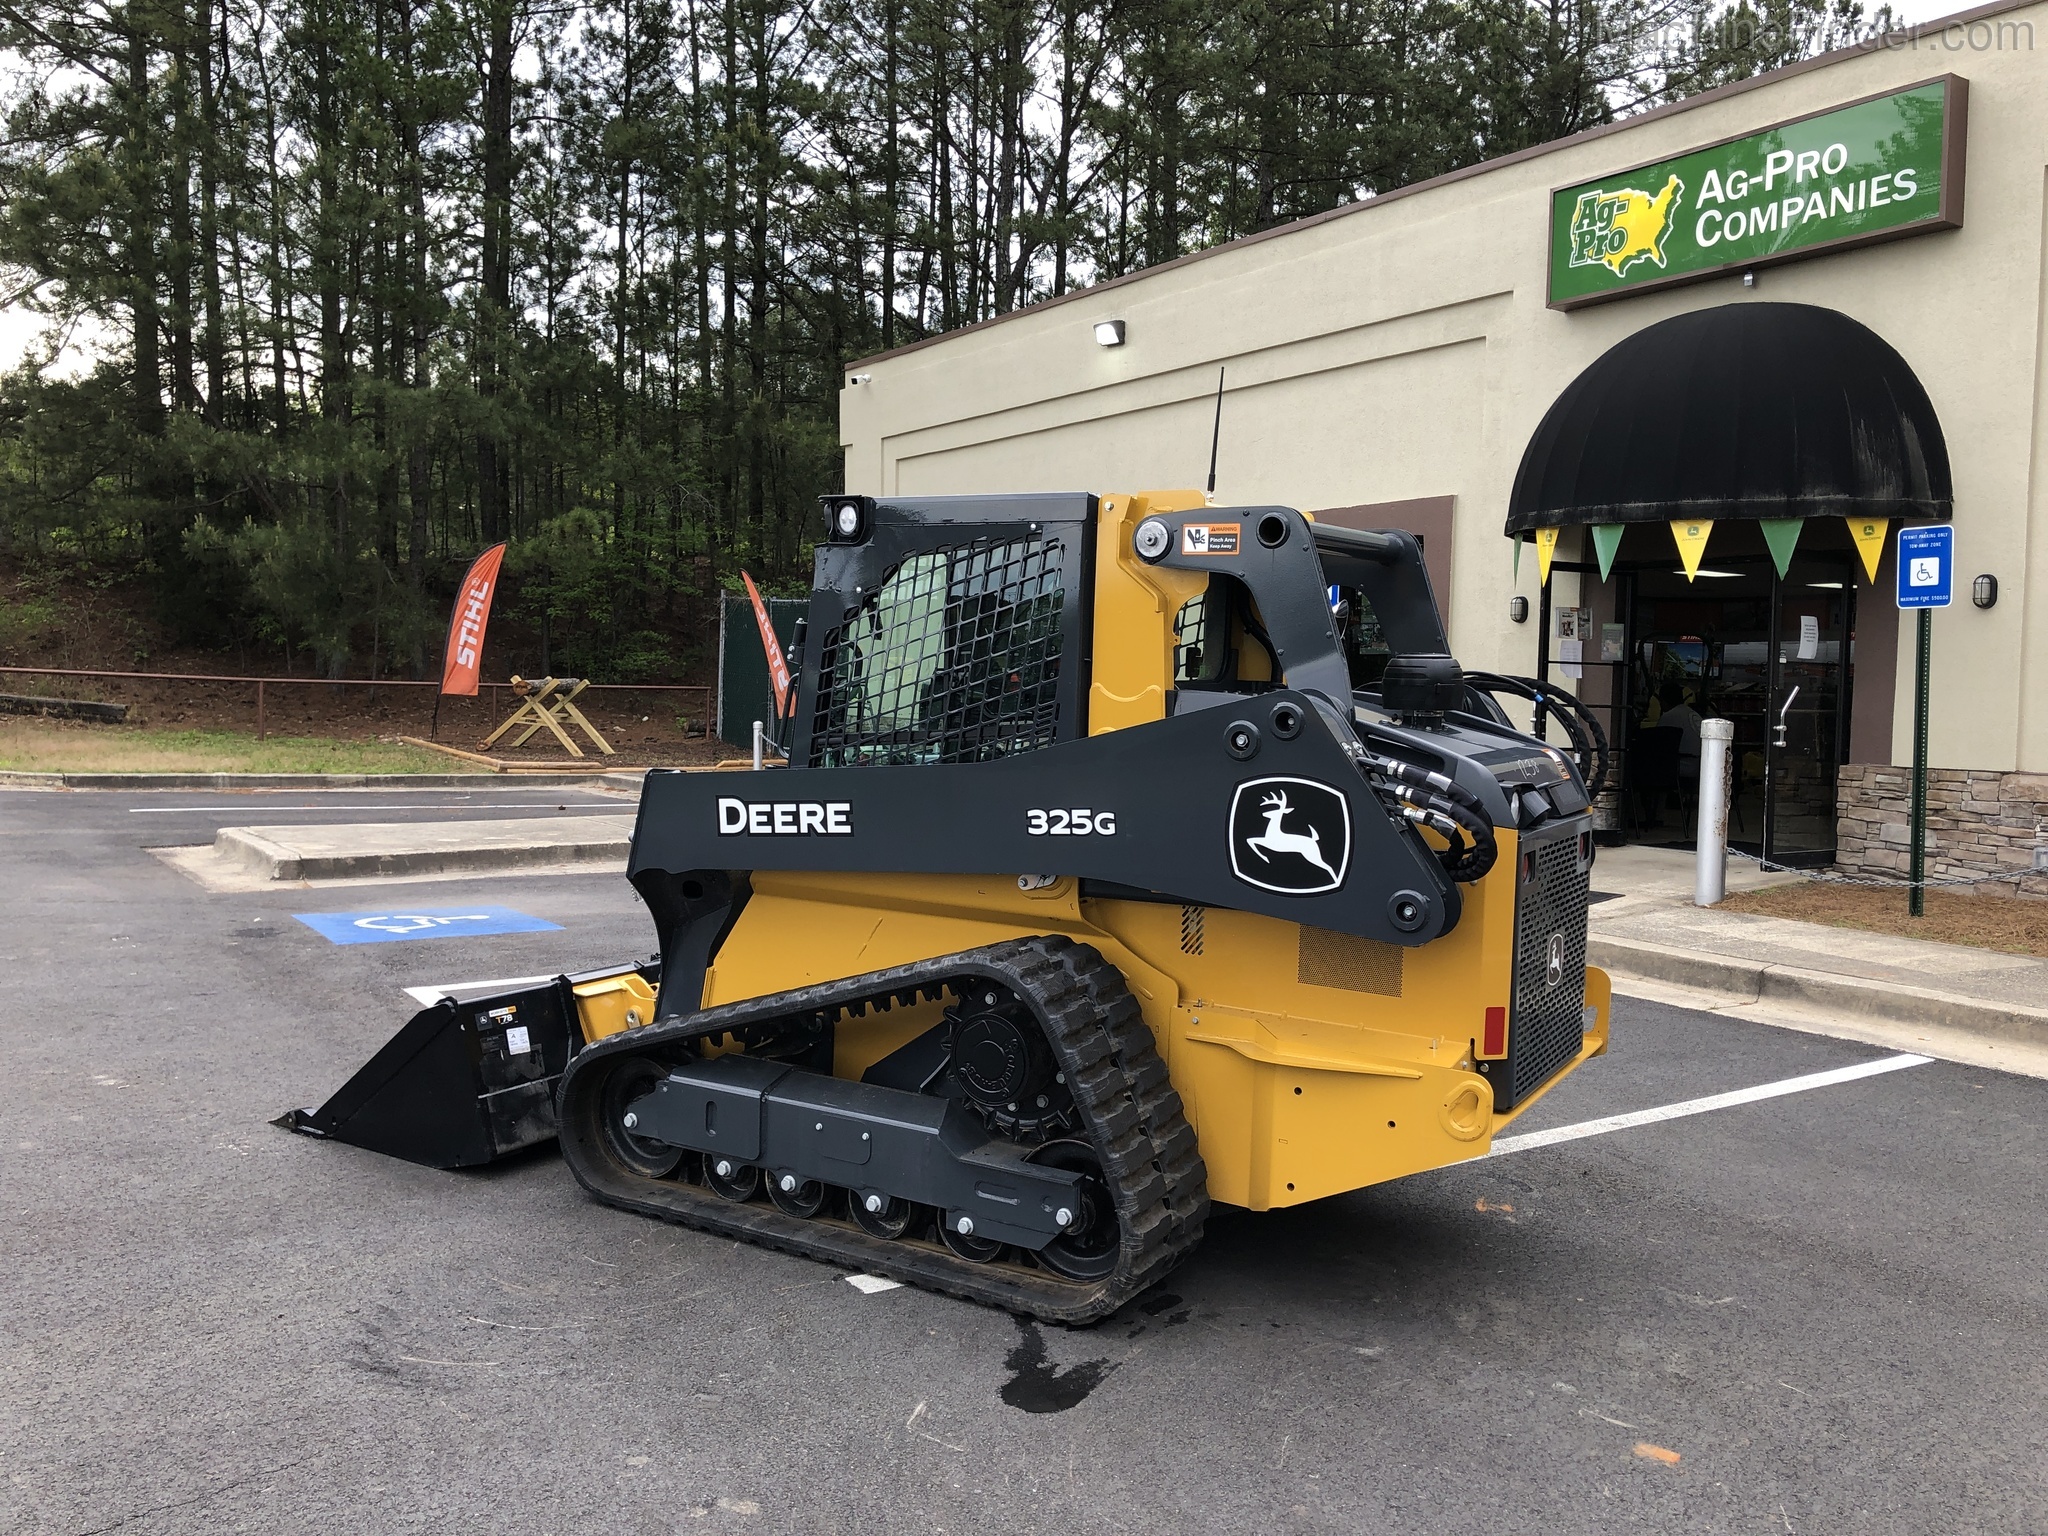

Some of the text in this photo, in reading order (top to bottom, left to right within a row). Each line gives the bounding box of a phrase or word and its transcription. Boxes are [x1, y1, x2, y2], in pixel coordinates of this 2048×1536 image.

[1696, 143, 1848, 209] AG-PRO
[1695, 169, 1918, 248] COMPANIES
[1572, 227, 1628, 264] Pro
[718, 798, 852, 834] DEERE
[1027, 809, 1116, 835] 325G
